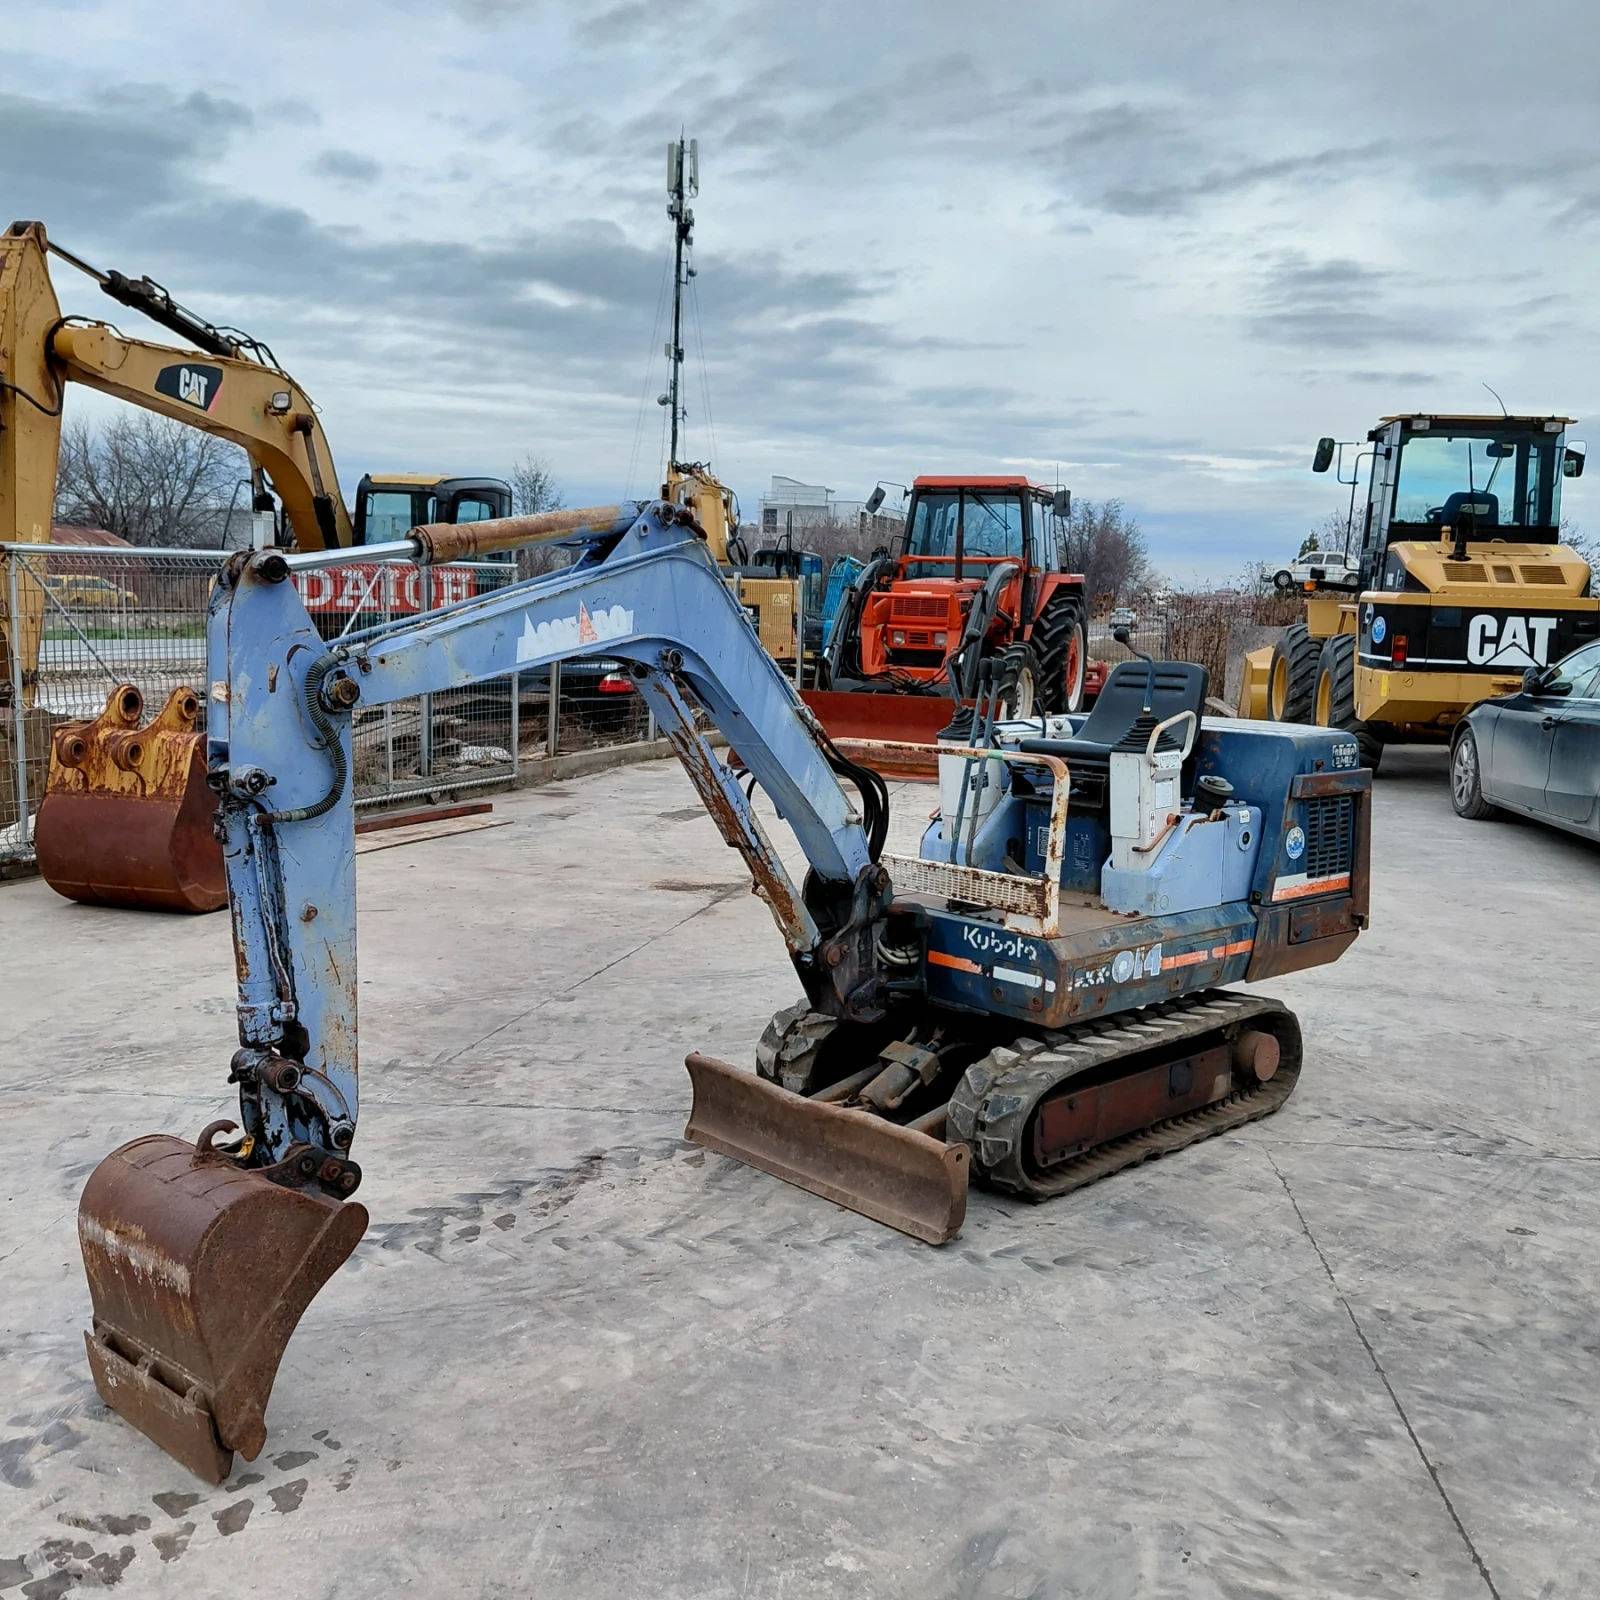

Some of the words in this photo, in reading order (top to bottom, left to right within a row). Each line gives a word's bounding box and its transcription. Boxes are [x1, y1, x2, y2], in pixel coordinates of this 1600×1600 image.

[179, 367, 208, 407] CAT
[1467, 614, 1557, 667] CAT
[963, 925, 1037, 961] Kubota
